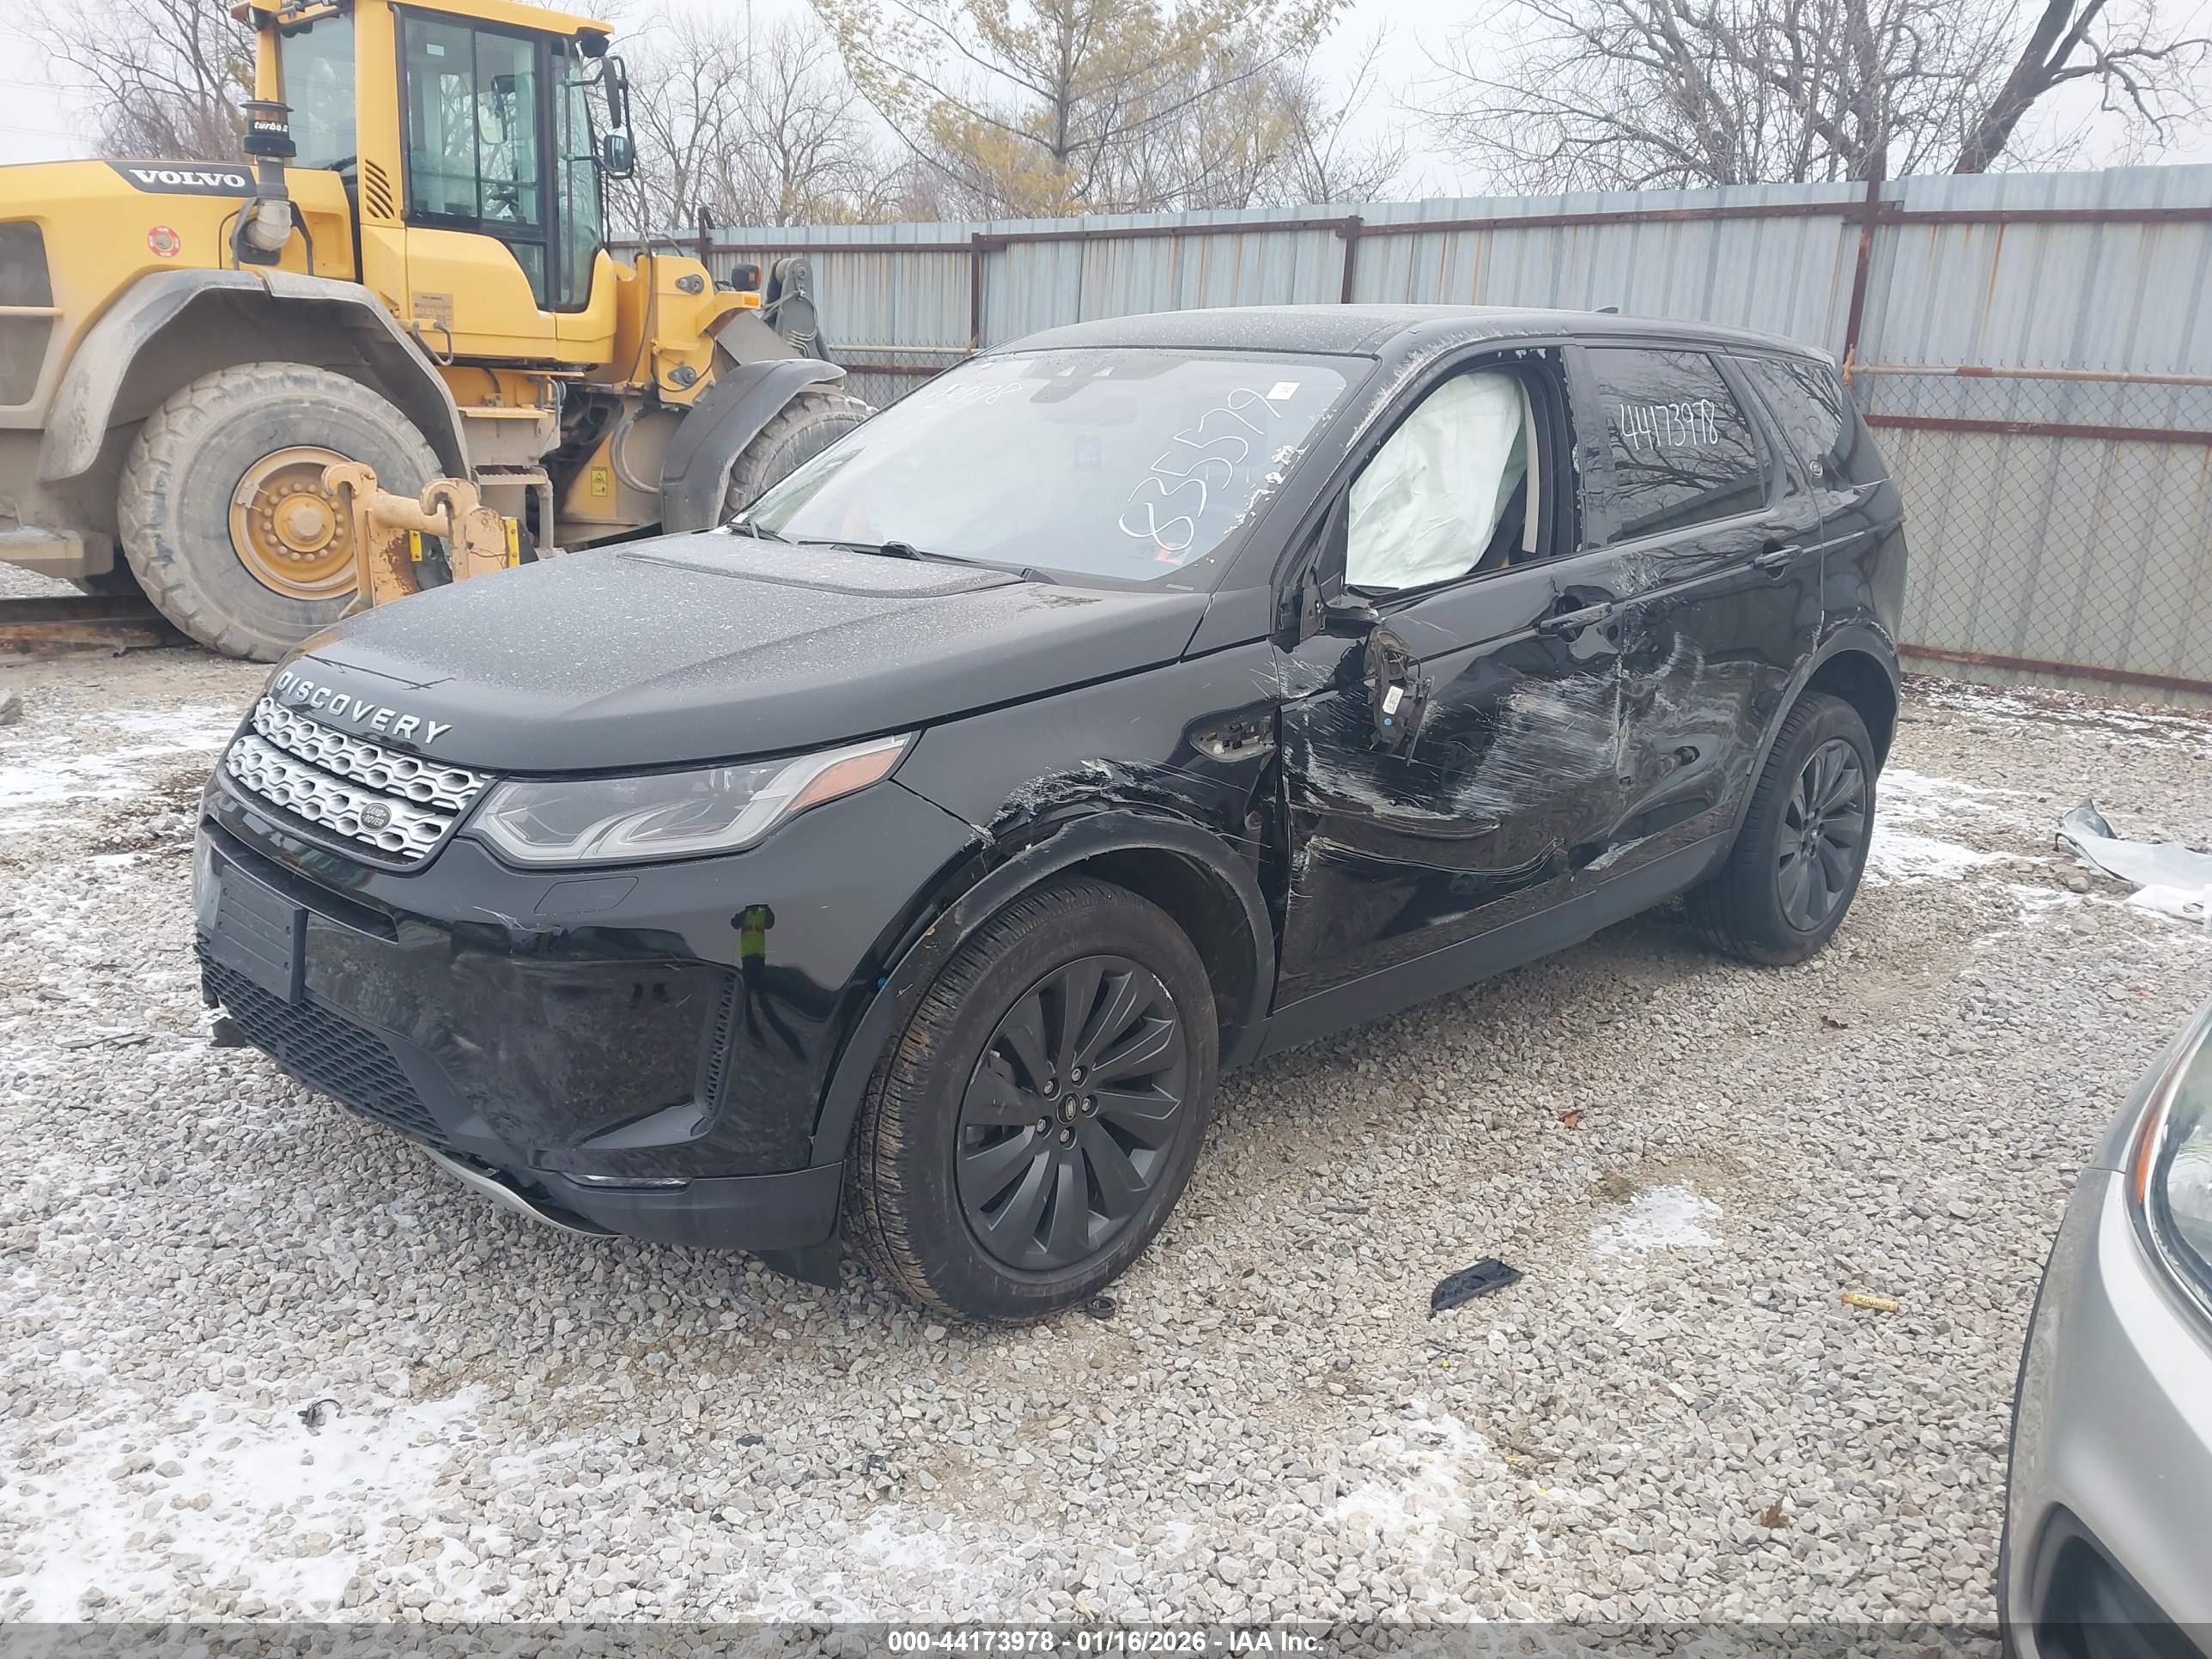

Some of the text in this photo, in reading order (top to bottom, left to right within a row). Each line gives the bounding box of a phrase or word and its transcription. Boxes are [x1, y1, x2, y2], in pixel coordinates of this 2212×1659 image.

[253, 121, 282, 131] turbo
[129, 169, 246, 187] VOLVO
[1620, 398, 1718, 451] 44173978
[276, 670, 453, 744] DISCOVERY
